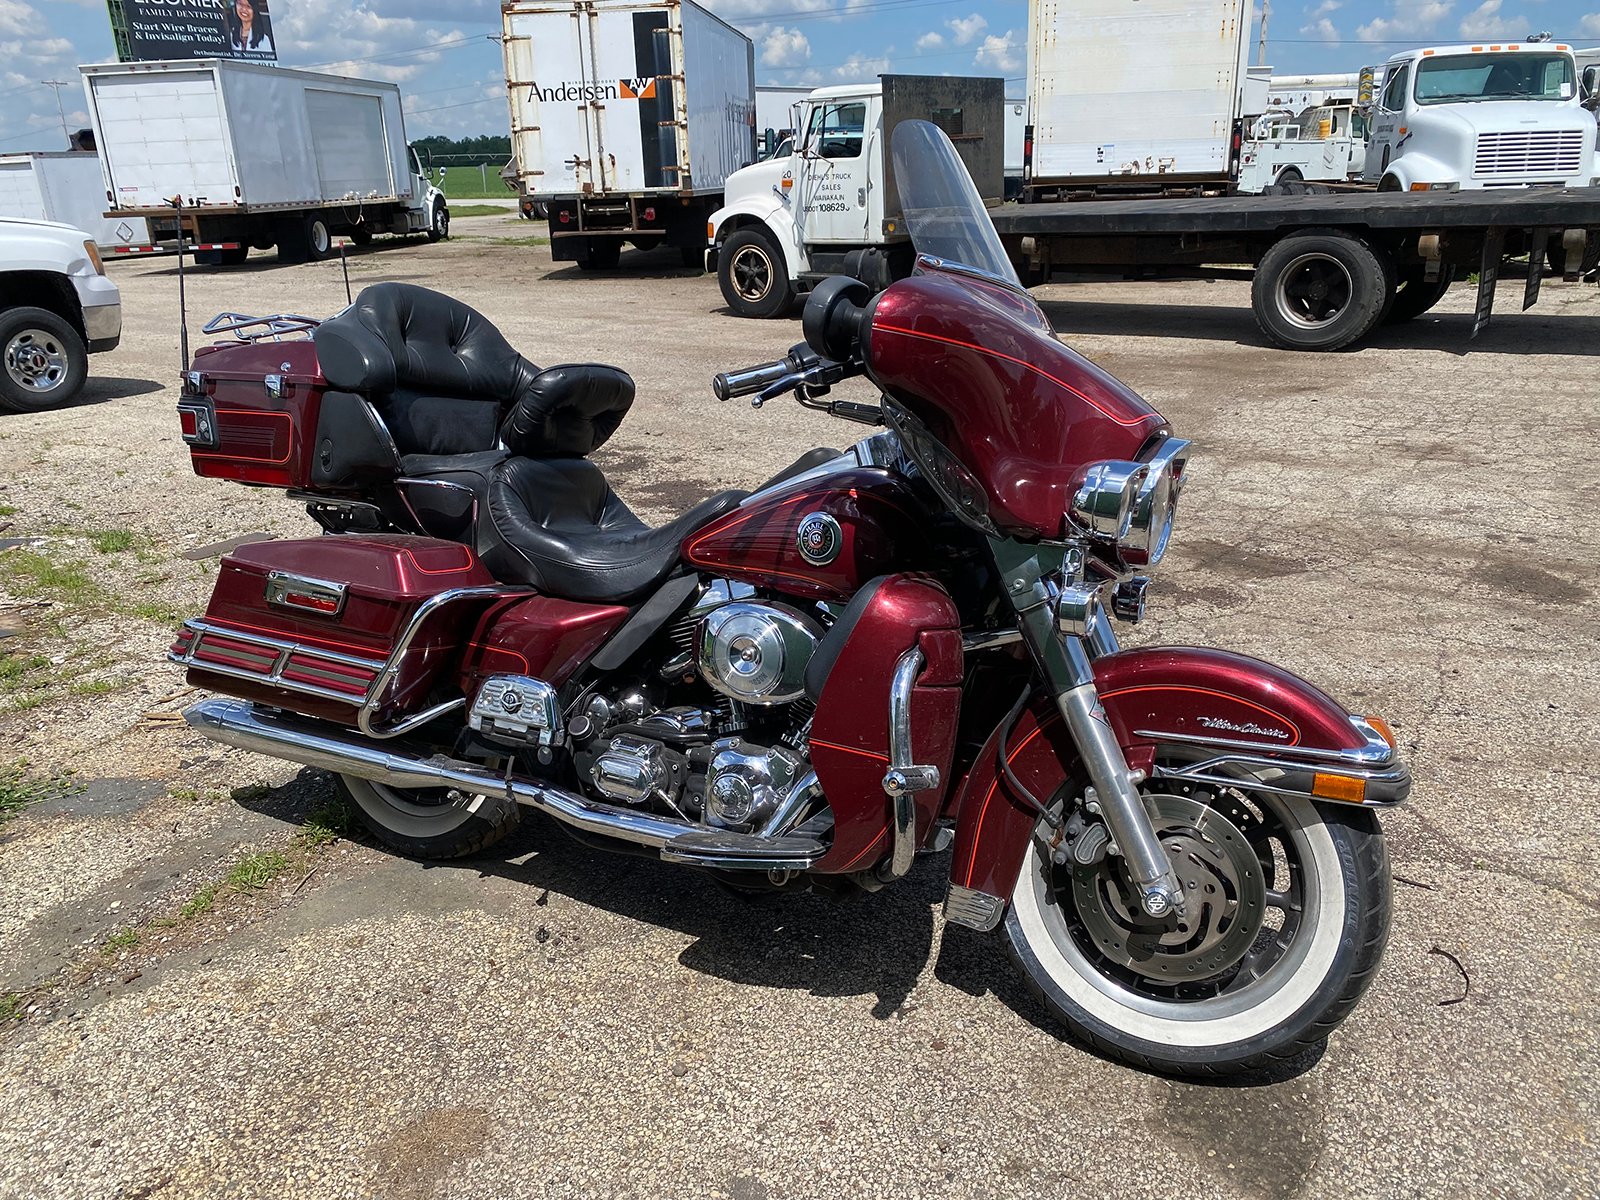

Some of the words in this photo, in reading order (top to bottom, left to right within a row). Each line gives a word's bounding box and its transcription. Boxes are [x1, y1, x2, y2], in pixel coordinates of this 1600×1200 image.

[139, 8, 173, 17] FAMILY
[176, 10, 224, 20] DENTISTRY
[132, 22, 160, 31] Start
[161, 23, 185, 32] Wire
[187, 24, 218, 34] Braces
[135, 31, 143, 40] &
[145, 32, 194, 43] Invisalign
[195, 34, 226, 44] Today!
[629, 78, 649, 89] AW
[527, 81, 617, 103] Andersen
